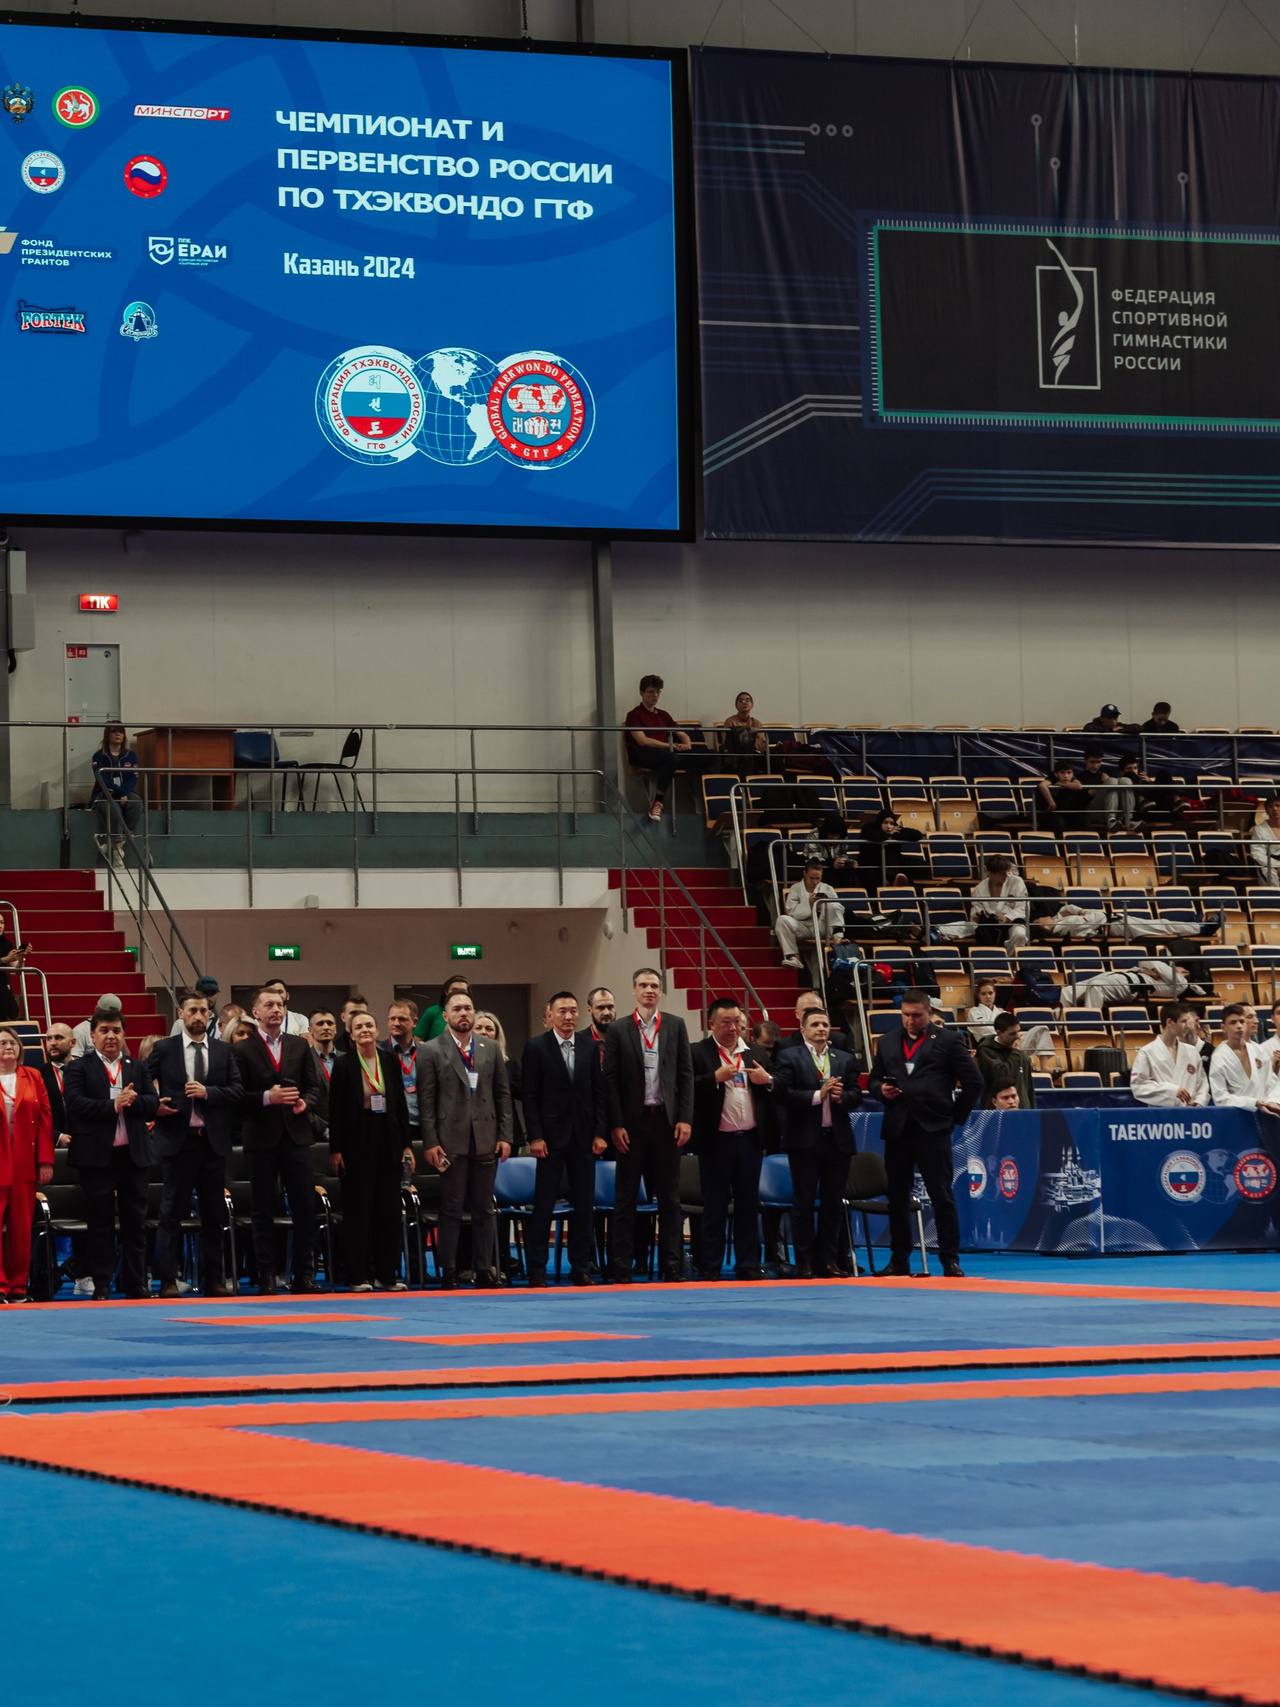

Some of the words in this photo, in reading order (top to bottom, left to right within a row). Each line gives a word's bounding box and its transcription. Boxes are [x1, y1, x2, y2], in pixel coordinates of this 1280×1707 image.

[135, 105, 230, 120] МИНСПОРТ
[275, 110, 472, 140] ЧЕМПИОНАТ
[482, 121, 505, 142] И
[277, 148, 480, 178] ПЕРВЕНСТВО
[489, 158, 613, 184] РОССИИ
[277, 186, 325, 209] ПО
[332, 188, 525, 221] ТХЭКВОНДО
[534, 198, 594, 220] ГТФ
[21, 239, 53, 248] ФОНД
[178, 243, 227, 259] ЕРАИ
[21, 248, 112, 258] ПРЕЗИДЕНТСКИХ
[21, 258, 70, 266] ГРАНТОВ
[283, 252, 360, 278] Казань
[363, 255, 416, 279] 2024
[1111, 289, 1216, 306] ФЕДЕРАЦИЯ
[21, 311, 86, 333] FORTEK
[1112, 310, 1228, 328] СПОРТИВНОЙ
[1112, 333, 1228, 350] ГИМНАСТИКИ
[1113, 355, 1182, 371] РОССИИ
[493, 362, 559, 394] TAEKWON-DO
[330, 368, 352, 436] ФЕДЕРАЦИЯ
[351, 358, 416, 391] ТХЭКВОНДО
[400, 393, 421, 439] РОССИИ
[559, 374, 584, 442] FEDERATION
[490, 397, 508, 440] GLOBAL
[366, 442, 387, 450] ГТФ
[523, 447, 550, 458] GTF
[1108, 1122, 1213, 1141] TAEKWON-DO
